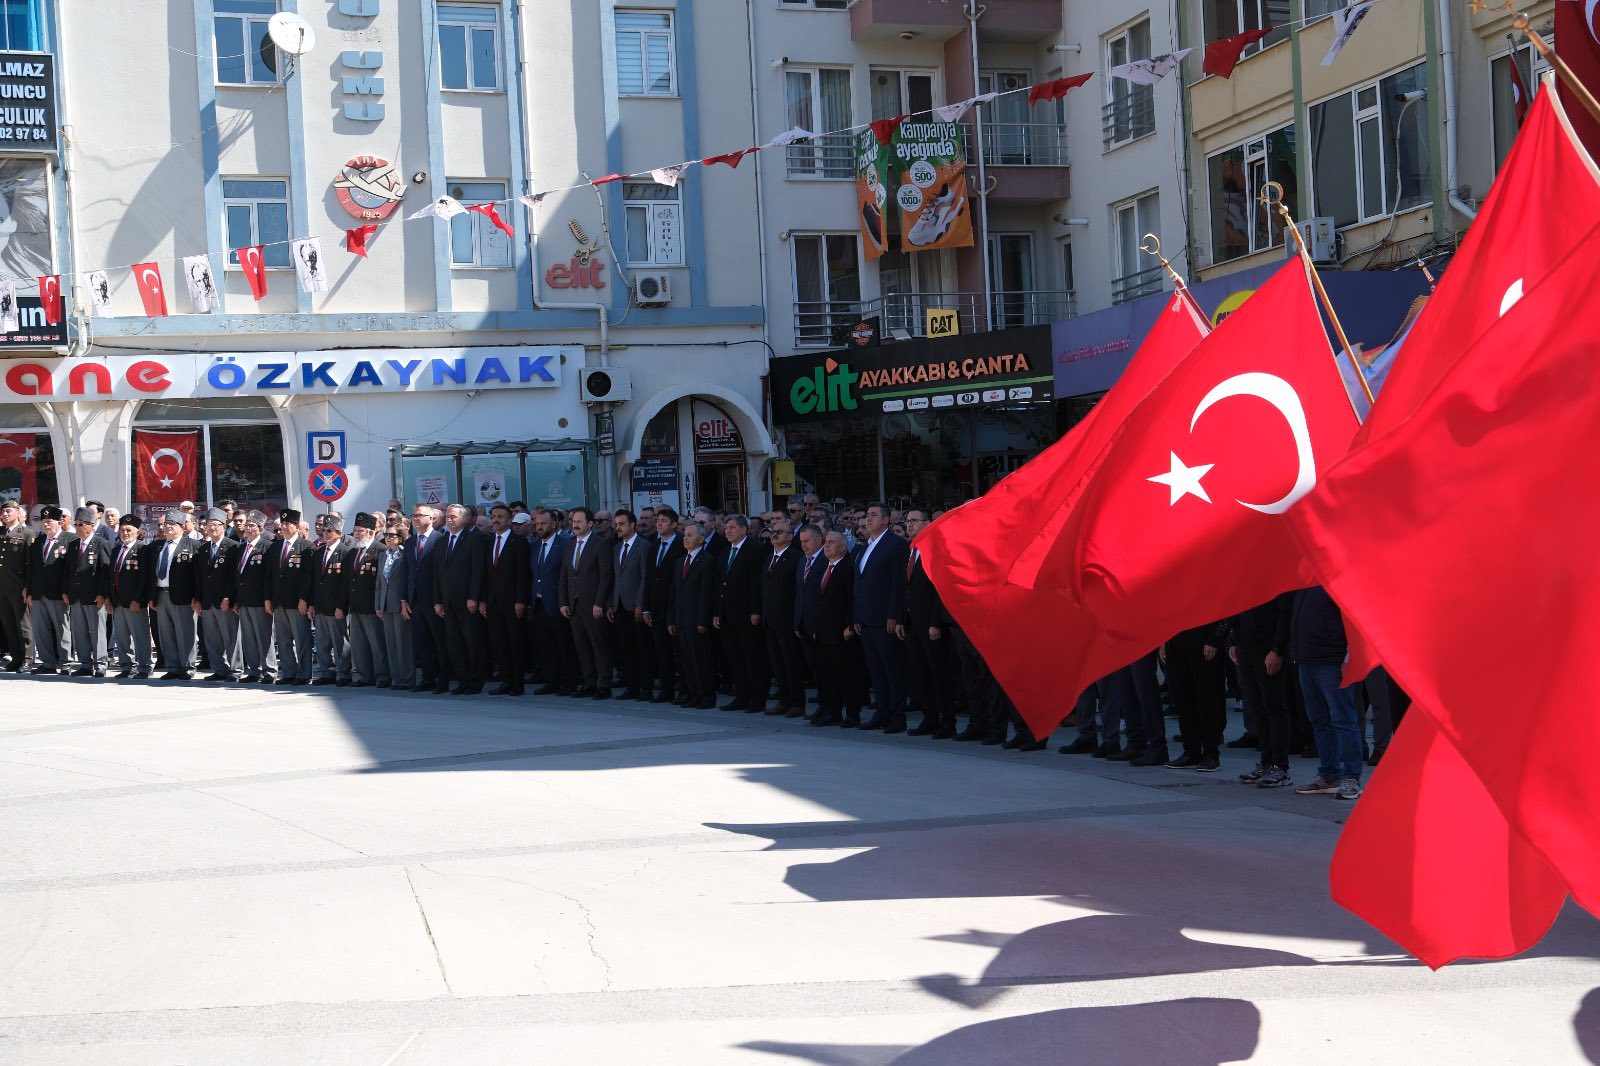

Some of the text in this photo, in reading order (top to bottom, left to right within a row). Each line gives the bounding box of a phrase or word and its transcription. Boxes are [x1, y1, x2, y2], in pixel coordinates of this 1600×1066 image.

[0, 84, 46, 99] UNCU
[15, 128, 30, 140] 97
[32, 128, 47, 140] 84
[900, 122, 956, 141] kampanya
[546, 257, 606, 288] elit
[930, 314, 954, 334] CAT
[207, 355, 555, 389] ÖZKAYNAK
[789, 357, 858, 414] elit
[858, 363, 945, 389] AYAKKABI
[962, 353, 1030, 380] ÇANTA
[698, 418, 730, 438] elit
[318, 440, 335, 461] D
